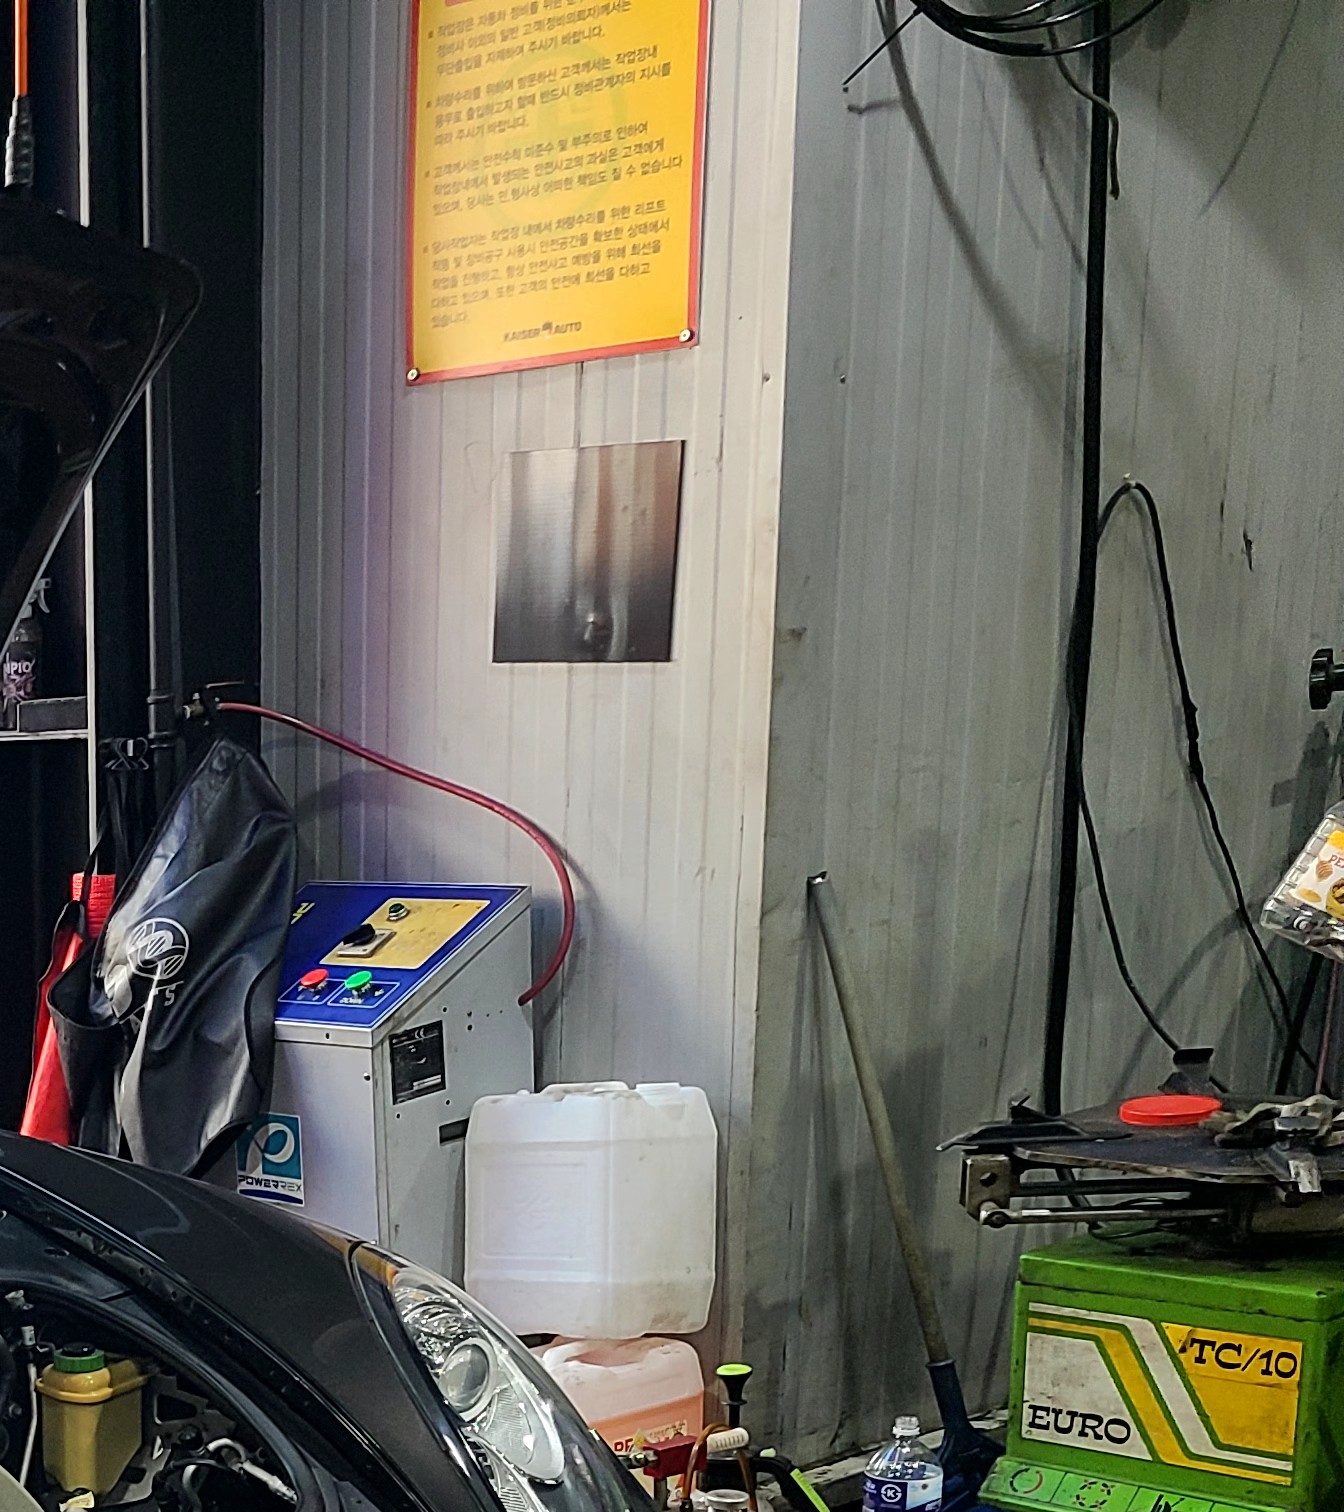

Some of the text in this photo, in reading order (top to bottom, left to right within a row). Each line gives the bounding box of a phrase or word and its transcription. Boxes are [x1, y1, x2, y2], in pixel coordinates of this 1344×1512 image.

[634, 199, 667, 215] 리프트
[554, 321, 582, 334] AUTO
[238, 1174, 302, 1192] POWERREX
[1189, 1337, 1299, 1380] TC/10
[1027, 1404, 1132, 1445] EURO
